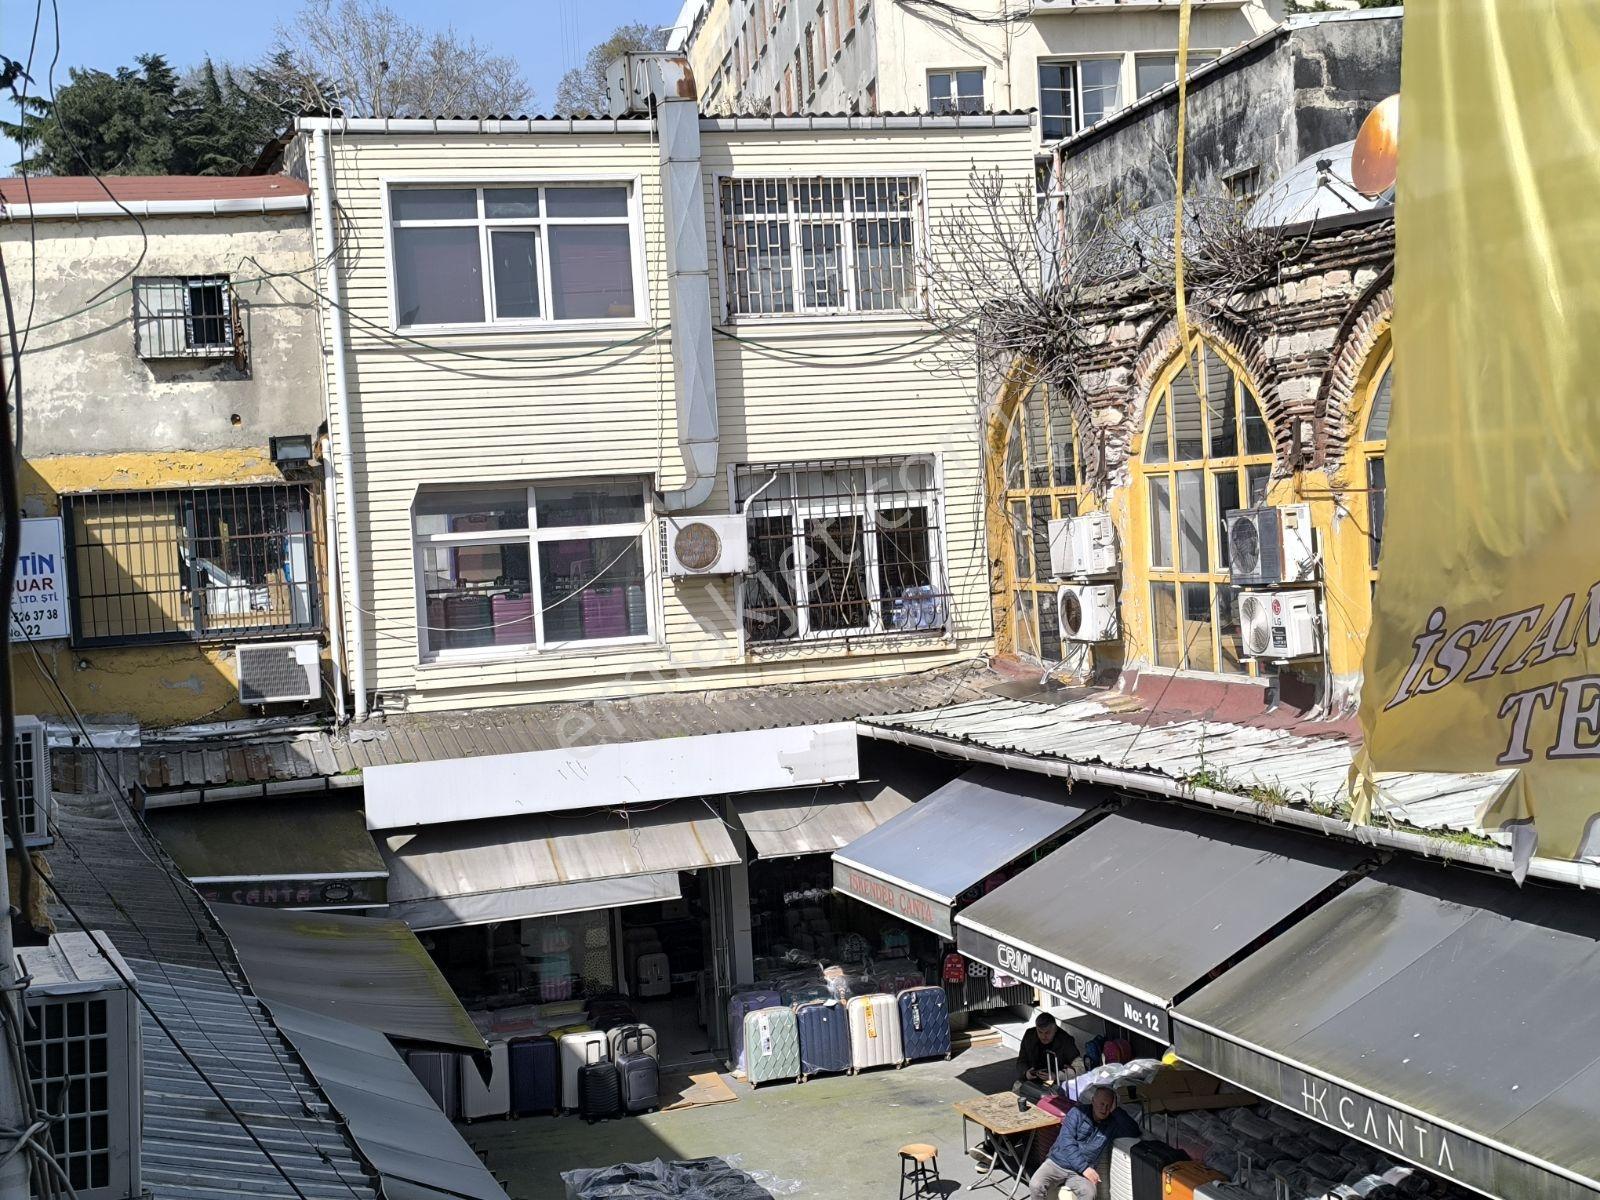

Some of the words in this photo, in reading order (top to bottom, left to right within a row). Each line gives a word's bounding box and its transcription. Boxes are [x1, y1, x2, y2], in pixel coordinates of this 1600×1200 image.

[15, 577, 54, 592] UAR
[33, 609, 44, 621] 37
[47, 608, 58, 620] 38
[27, 624, 41, 636] 22
[1124, 1002, 1143, 1024] No:
[1145, 1012, 1160, 1032] 12
[1301, 1078, 1329, 1121] HK
